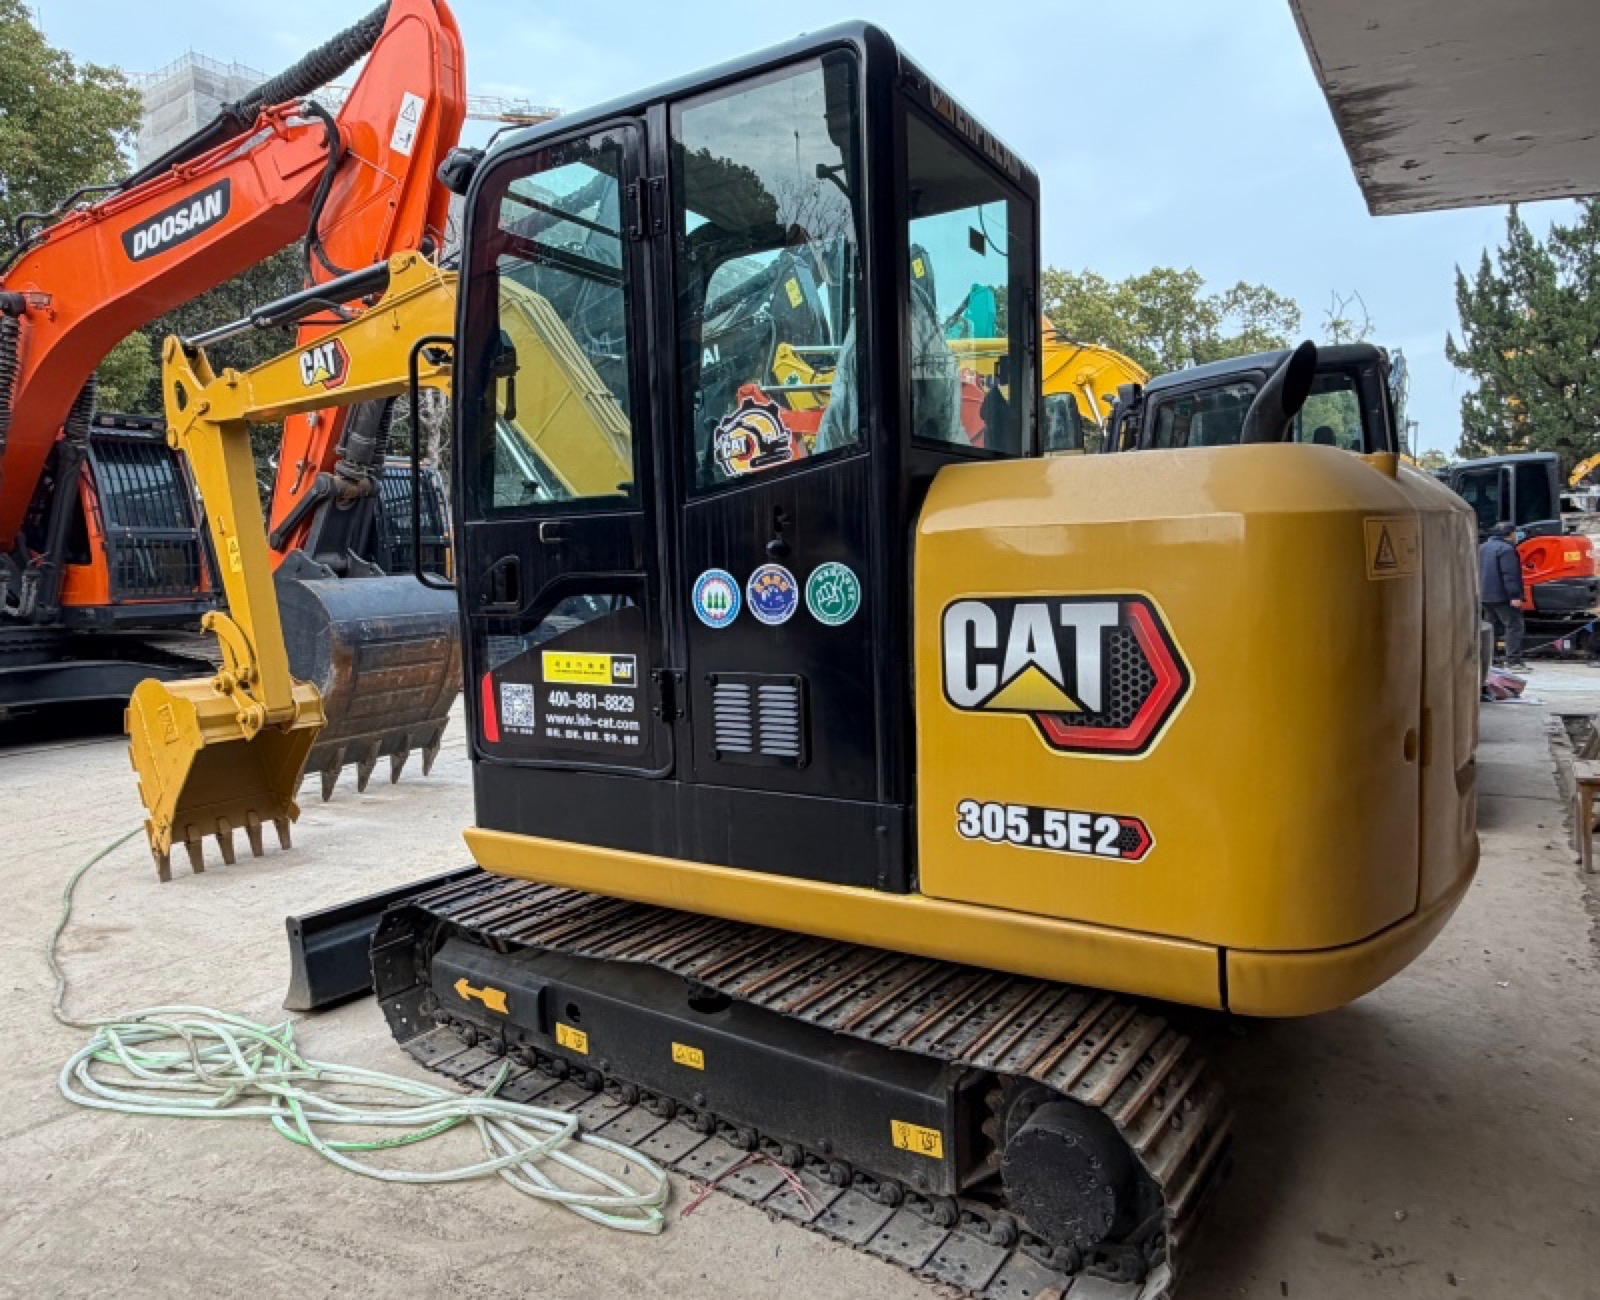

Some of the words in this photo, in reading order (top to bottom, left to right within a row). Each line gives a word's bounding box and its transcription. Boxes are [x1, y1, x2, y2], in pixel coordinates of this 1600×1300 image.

[133, 189, 222, 259] DOOSAN
[300, 341, 335, 385] CAT
[722, 436, 747, 458] CAT
[613, 662, 633, 677] CAT
[943, 601, 1119, 713] CAT
[547, 690, 635, 713] 400-881-8829
[957, 800, 1121, 856] 305.5E2
